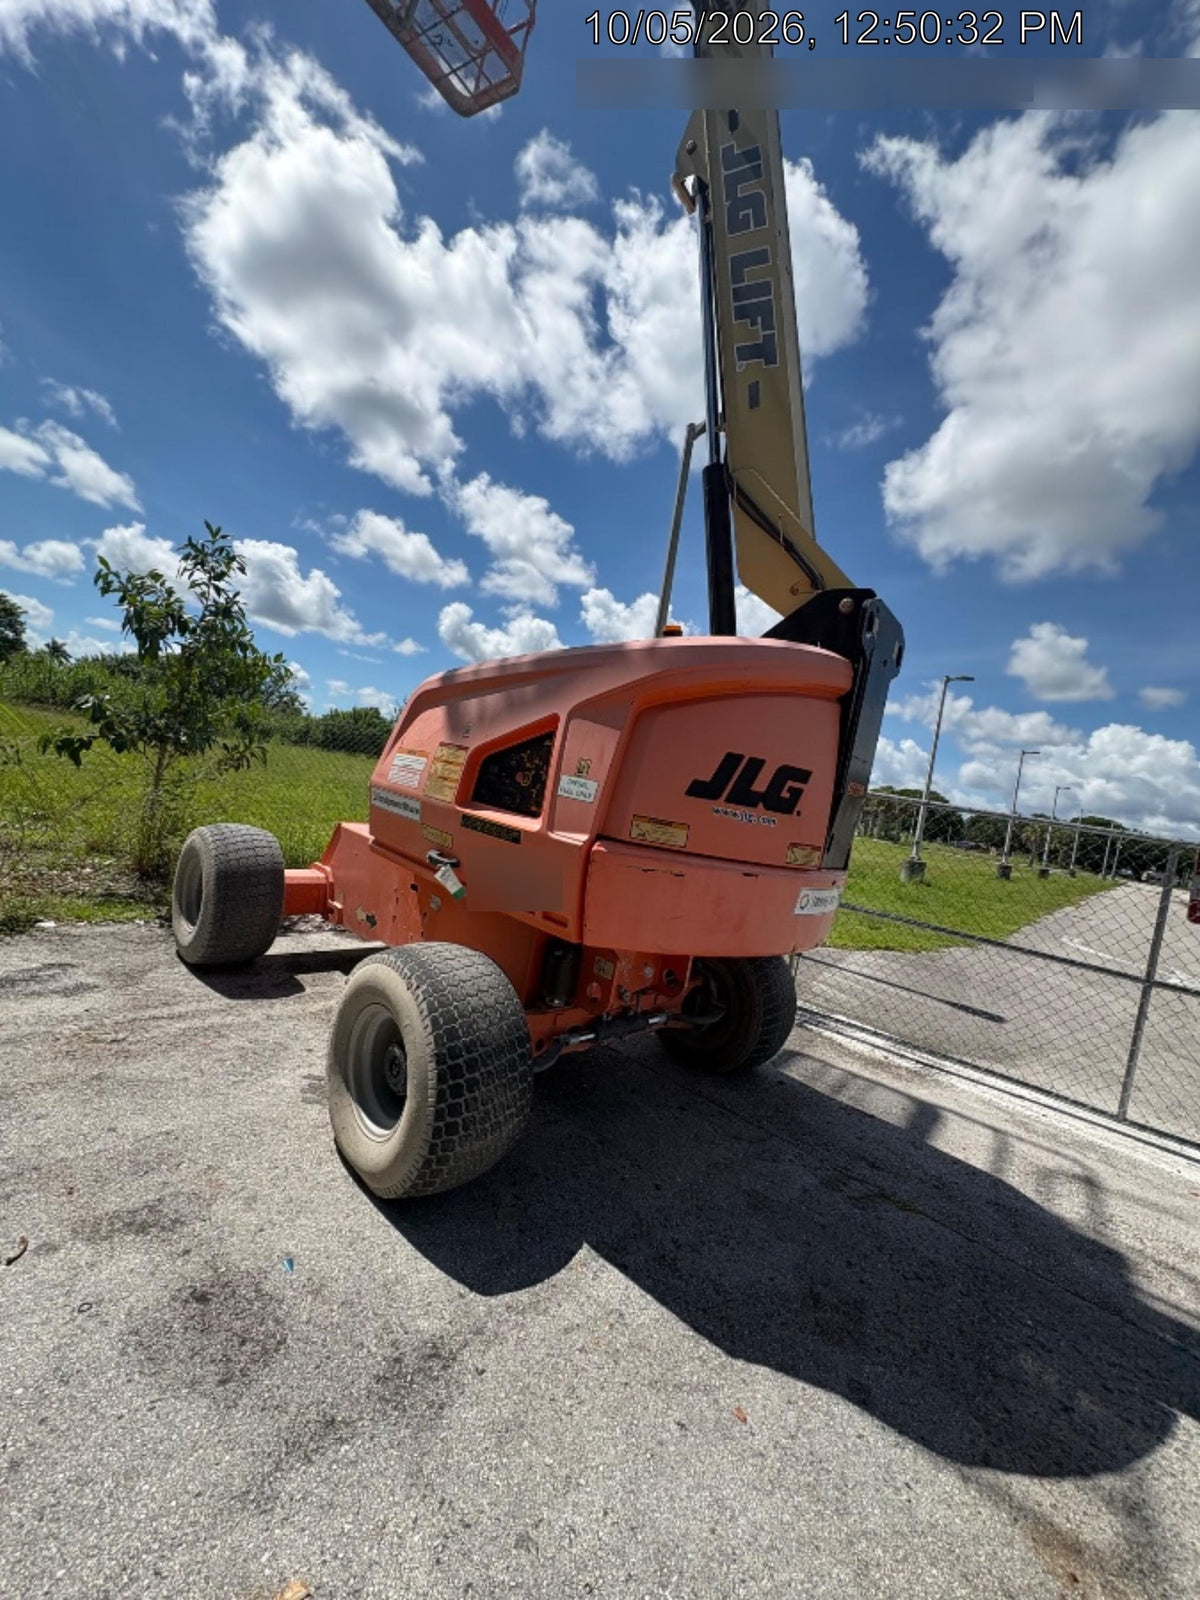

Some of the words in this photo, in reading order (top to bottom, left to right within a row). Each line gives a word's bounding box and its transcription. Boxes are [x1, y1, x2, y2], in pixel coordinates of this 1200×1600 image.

[720, 142, 769, 237] JLG
[729, 246, 780, 369] LIFT
[684, 751, 813, 815] JLG
[712, 806, 778, 828] www.jlg.com
